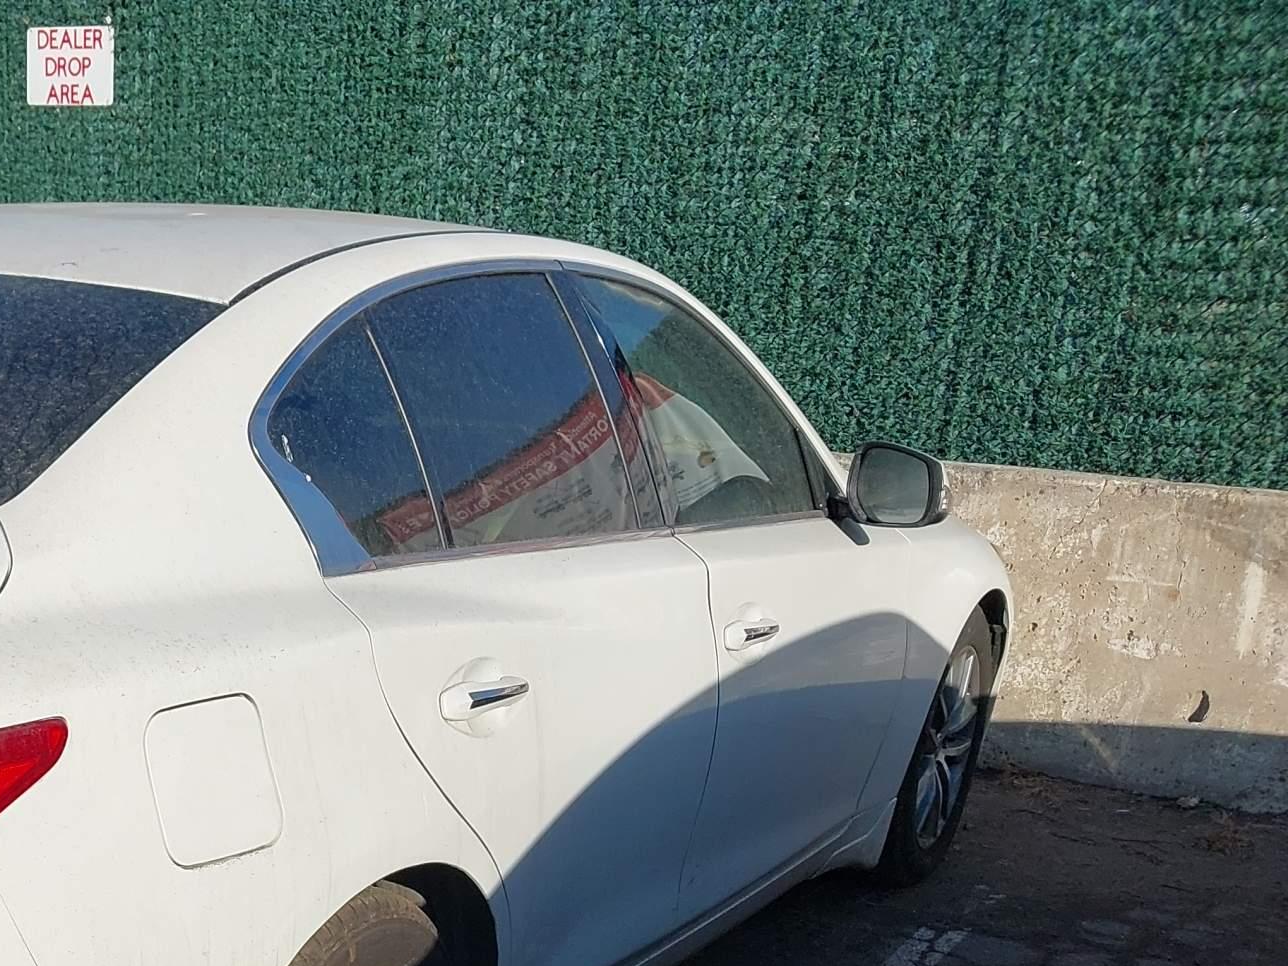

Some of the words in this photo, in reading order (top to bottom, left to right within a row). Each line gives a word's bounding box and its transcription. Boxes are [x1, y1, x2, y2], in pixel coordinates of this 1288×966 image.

[37, 29, 103, 49] DEALER
[45, 57, 92, 77] DROP
[46, 84, 95, 104] AREA
